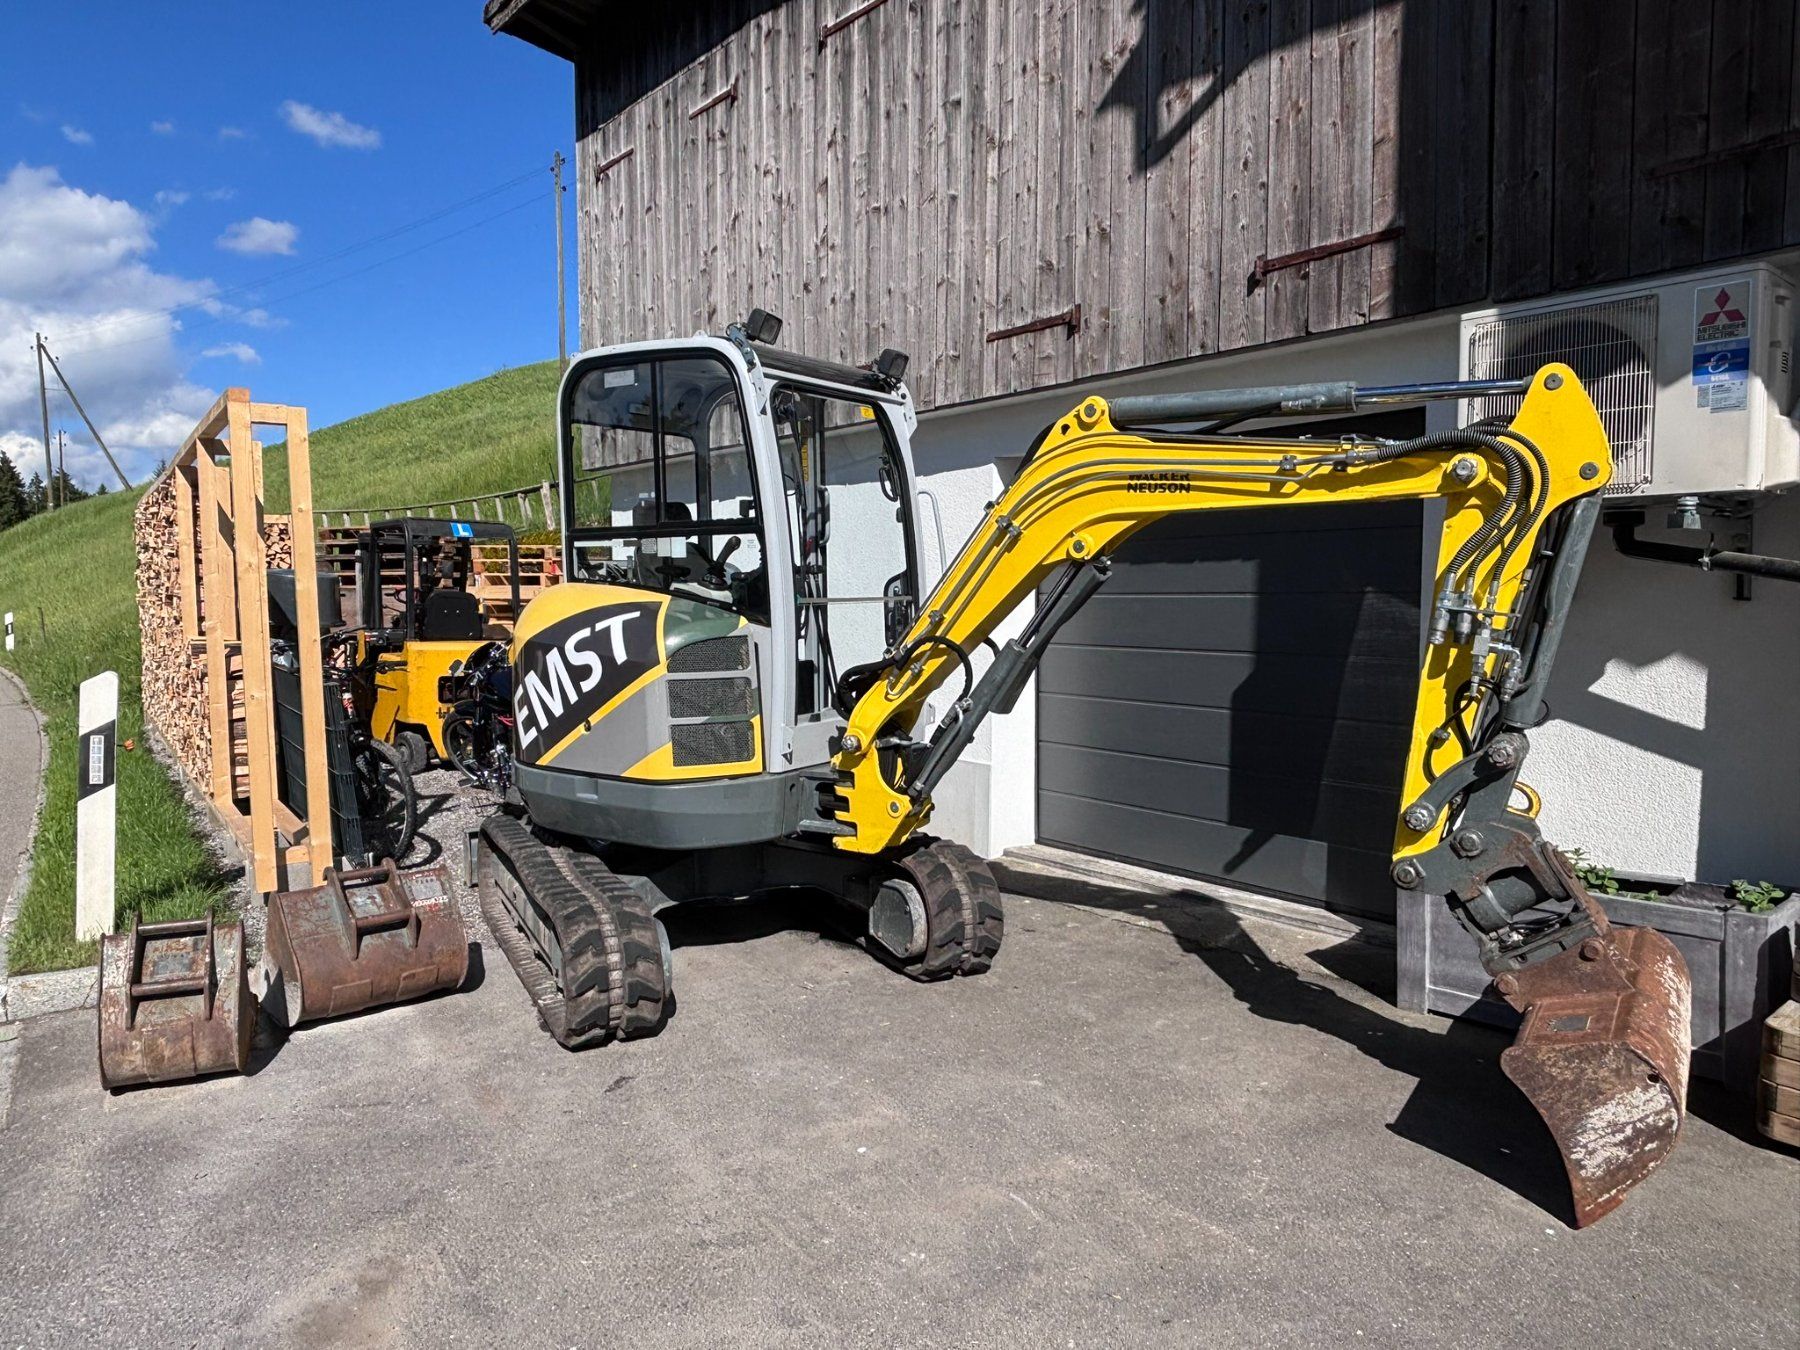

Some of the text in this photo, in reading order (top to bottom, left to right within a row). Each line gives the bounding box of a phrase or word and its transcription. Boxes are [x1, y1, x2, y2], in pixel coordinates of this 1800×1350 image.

[1697, 321, 1746, 335] MITSUBISHI
[1697, 330, 1740, 341] ELECTRIC
[1127, 482, 1191, 493] NEUSON
[456, 523, 470, 536] L
[514, 611, 641, 750] EMST
